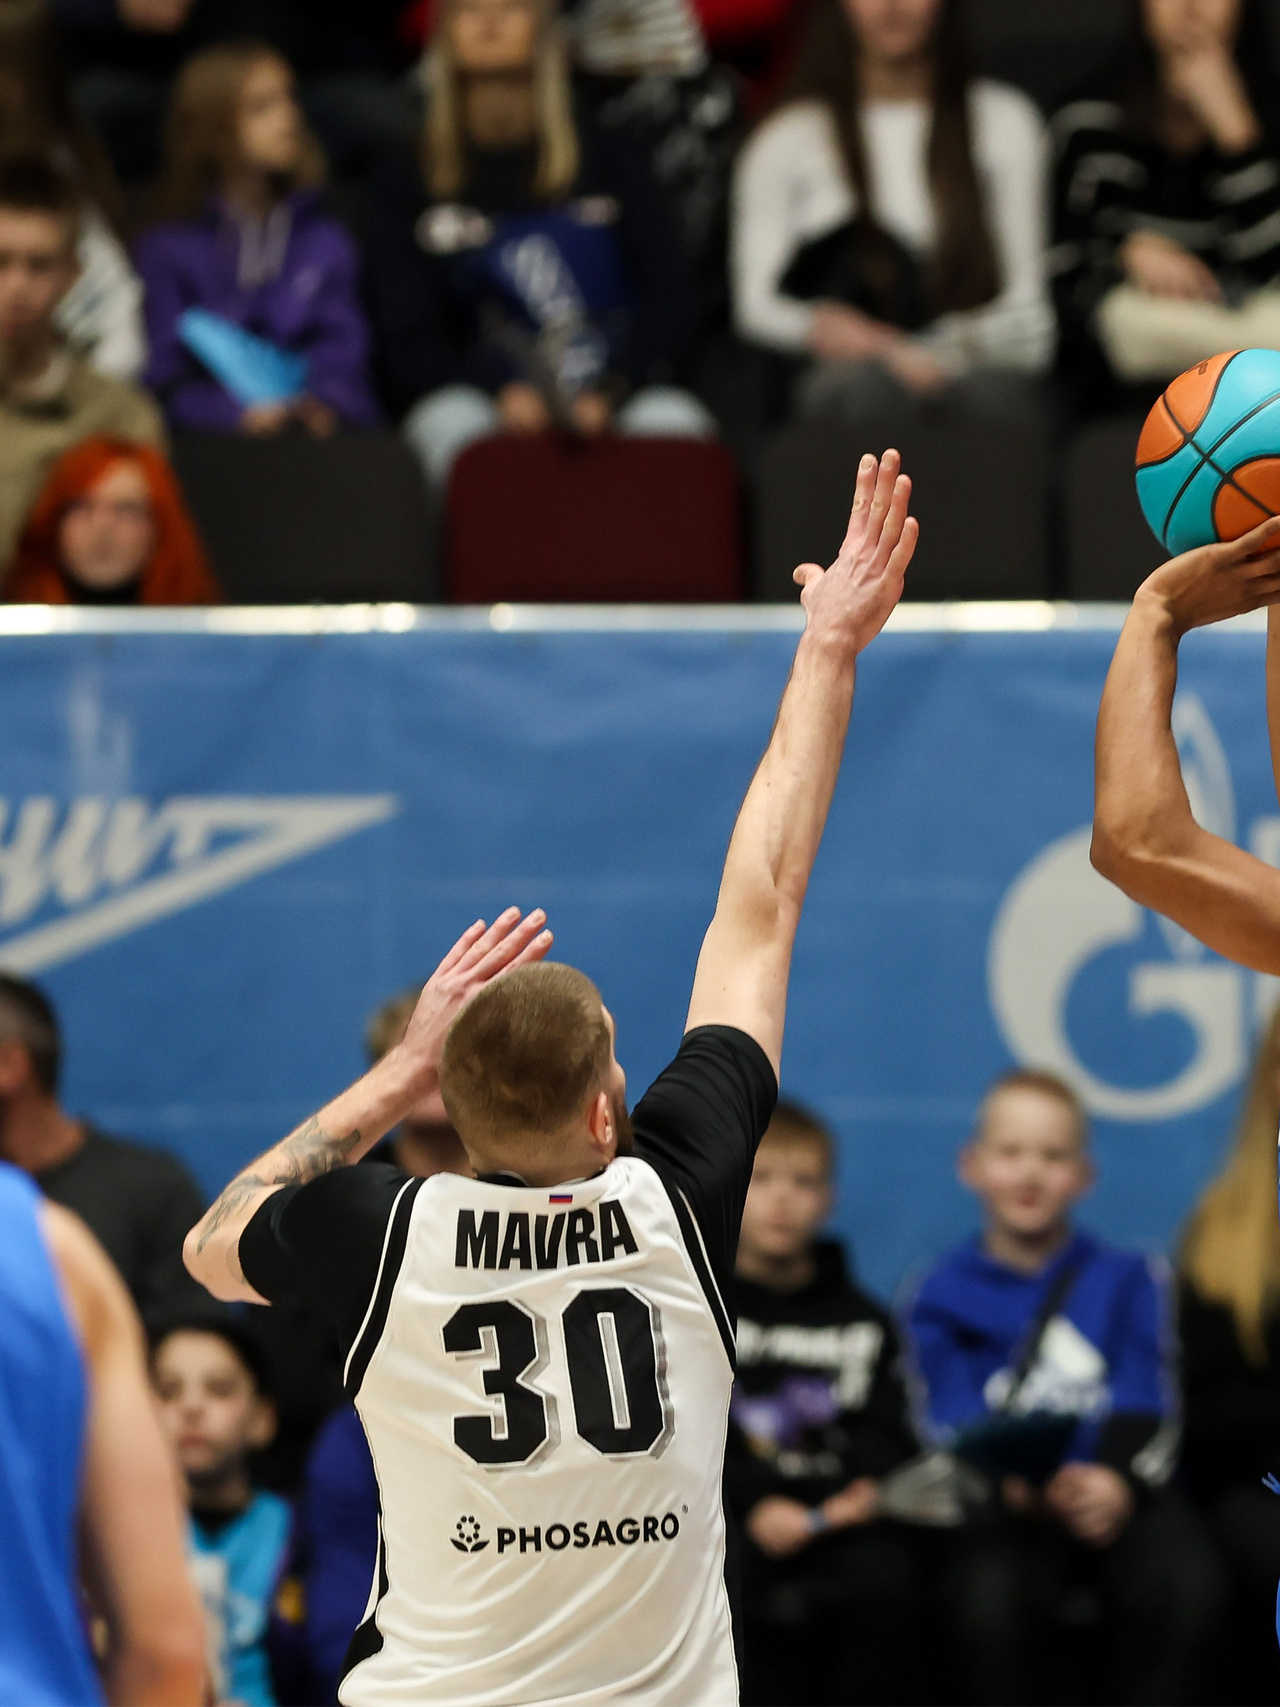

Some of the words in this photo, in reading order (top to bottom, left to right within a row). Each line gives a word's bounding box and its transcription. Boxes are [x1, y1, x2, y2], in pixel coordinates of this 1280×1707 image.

[455, 1199, 639, 1271] MAVRA
[441, 1286, 675, 1473] 30
[496, 1512, 680, 1554] PHOSAGRO
